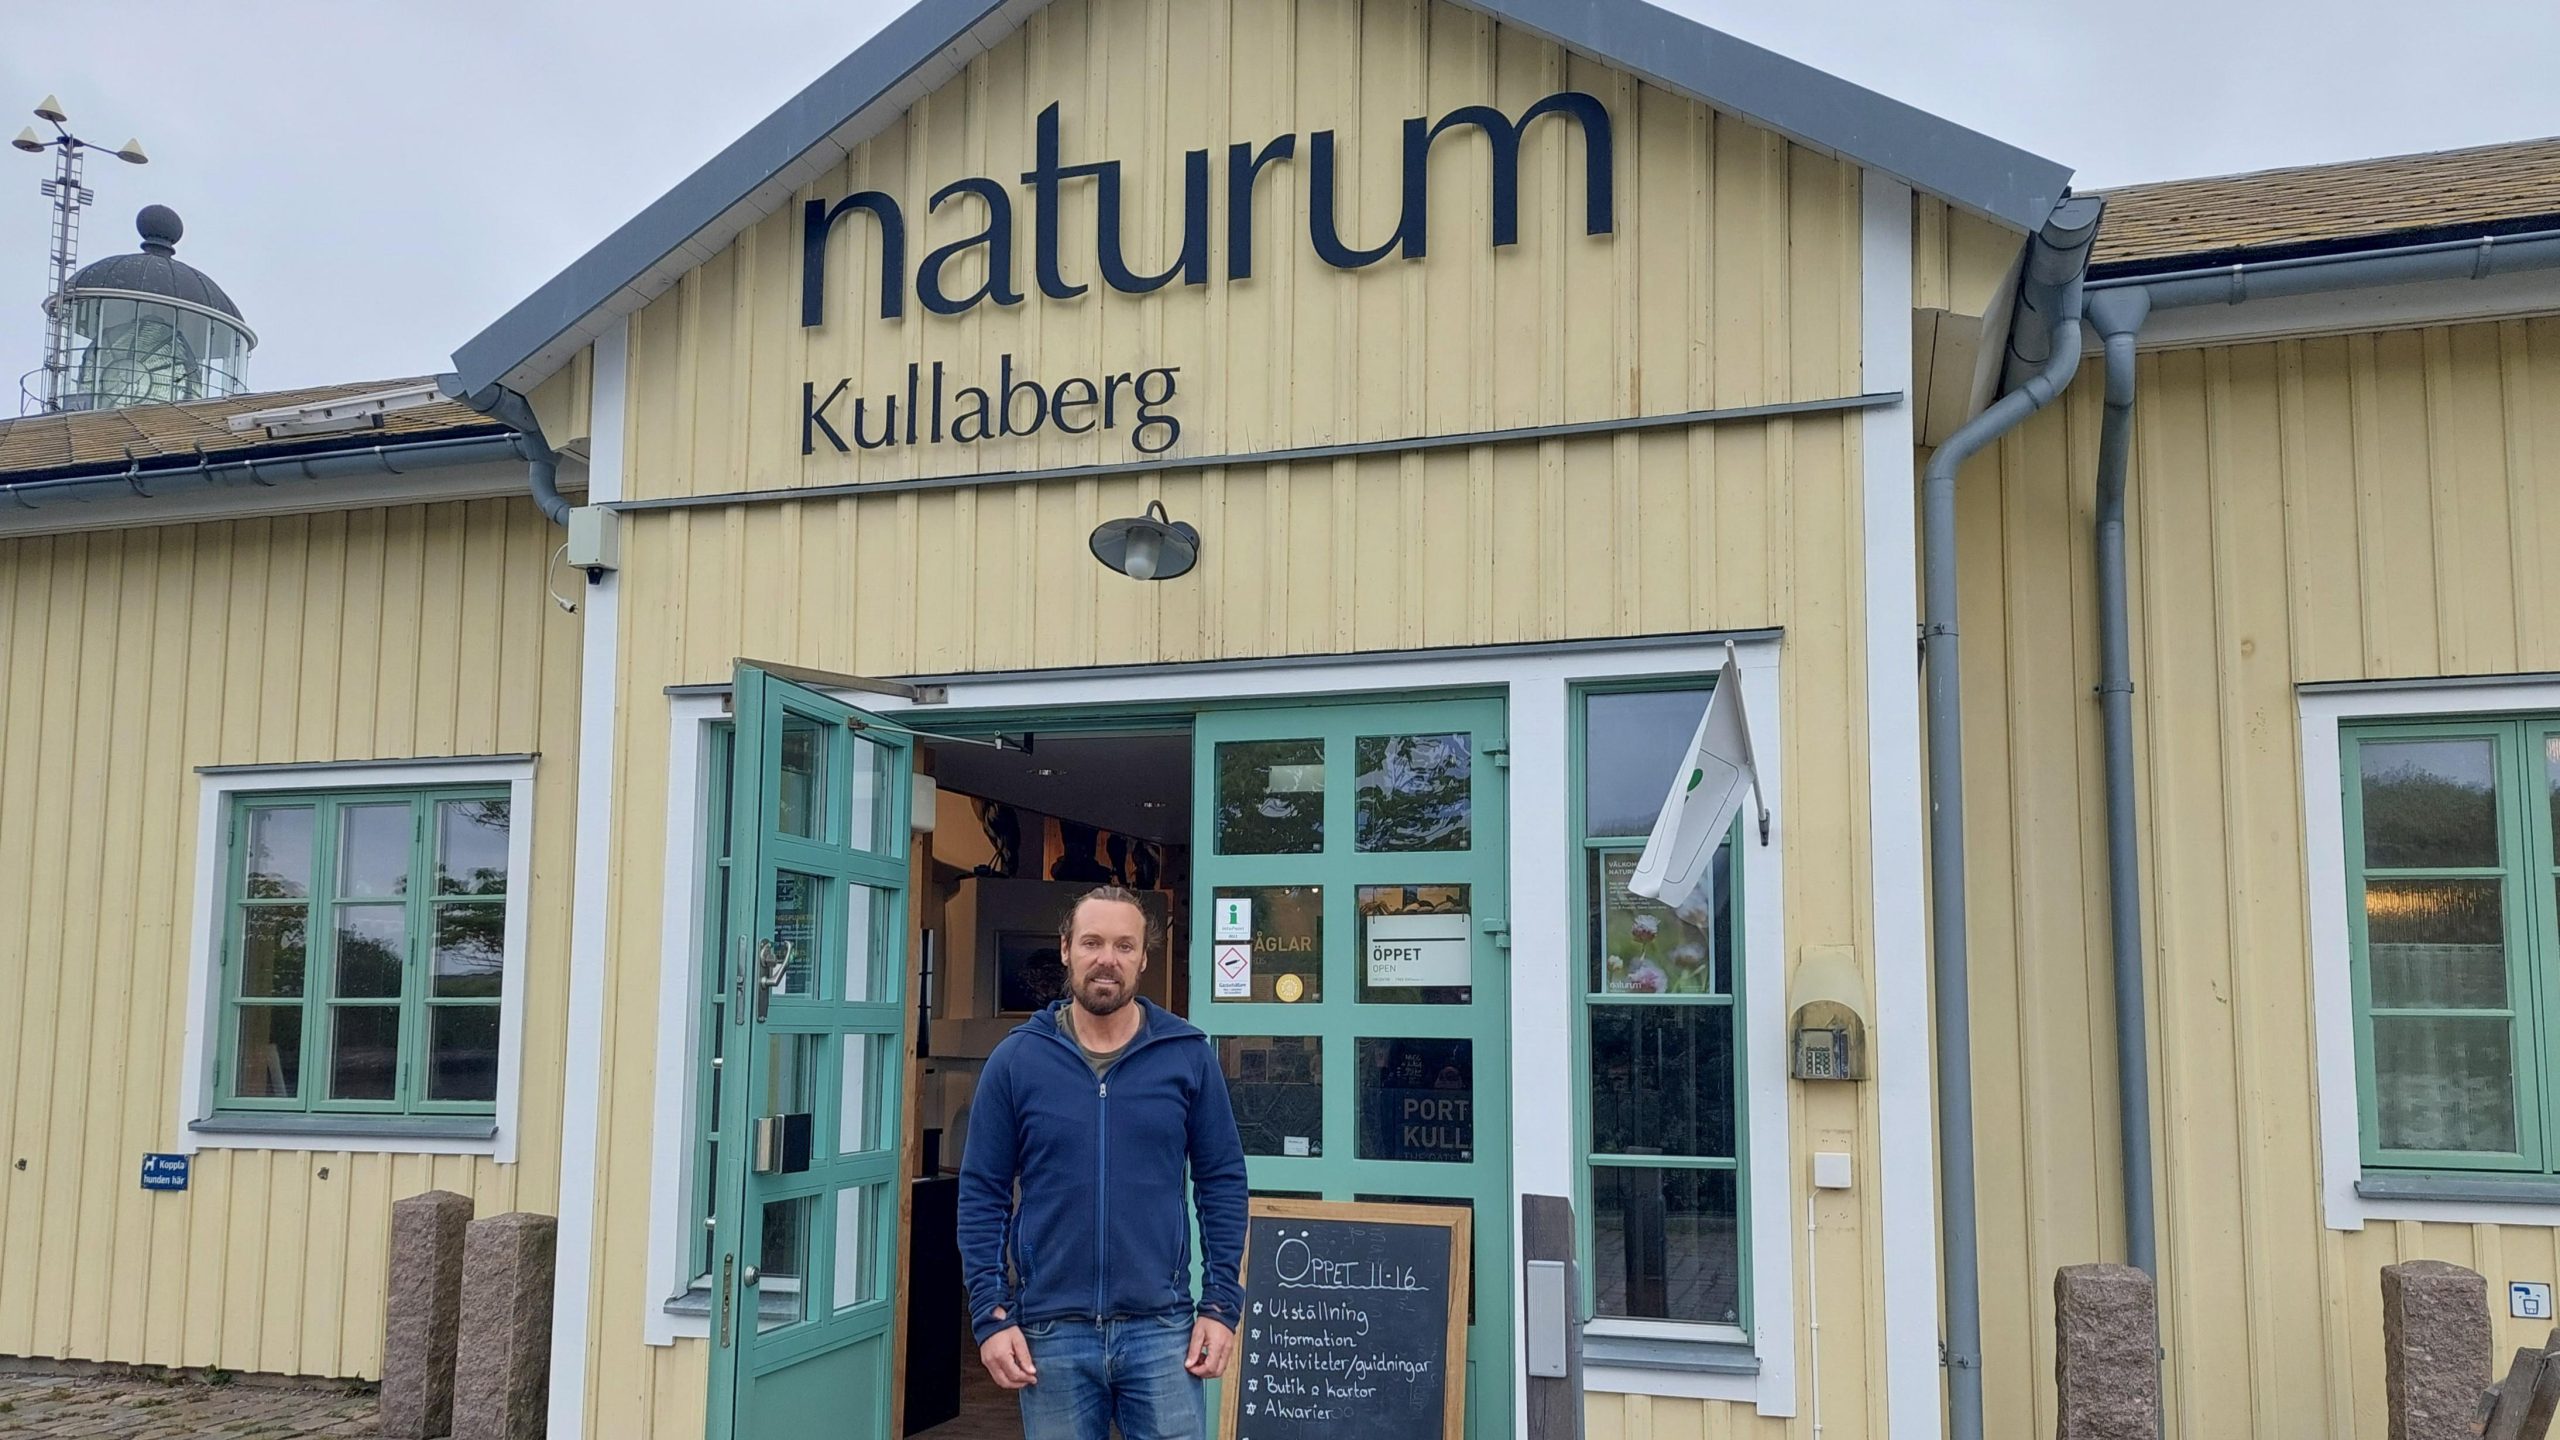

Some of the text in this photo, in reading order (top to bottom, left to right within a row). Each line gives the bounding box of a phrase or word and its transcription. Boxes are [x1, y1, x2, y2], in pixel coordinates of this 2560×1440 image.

[802, 91, 1614, 328] naturum
[802, 353, 1182, 456] Kullaberg
[1251, 930, 1312, 952] ÅGLAR
[1373, 945, 1422, 961] ÖPPET
[1372, 964, 1397, 973] OPEN
[1403, 1098, 1470, 1121] PORT
[1403, 1125, 1472, 1149] KULL
[159, 1159, 185, 1171] Koppla
[143, 1174, 185, 1185] hunden här
[1275, 1228, 1359, 1286] ÖPPET
[1269, 1298, 1369, 1336] Utställning
[1269, 1324, 1357, 1348] Information
[1267, 1353, 1433, 1383] Aktiviteter/guidningar
[1263, 1375, 1305, 1395] Butik
[1326, 1378, 1377, 1398] kartor
[1264, 1399, 1334, 1420] Akvarier
